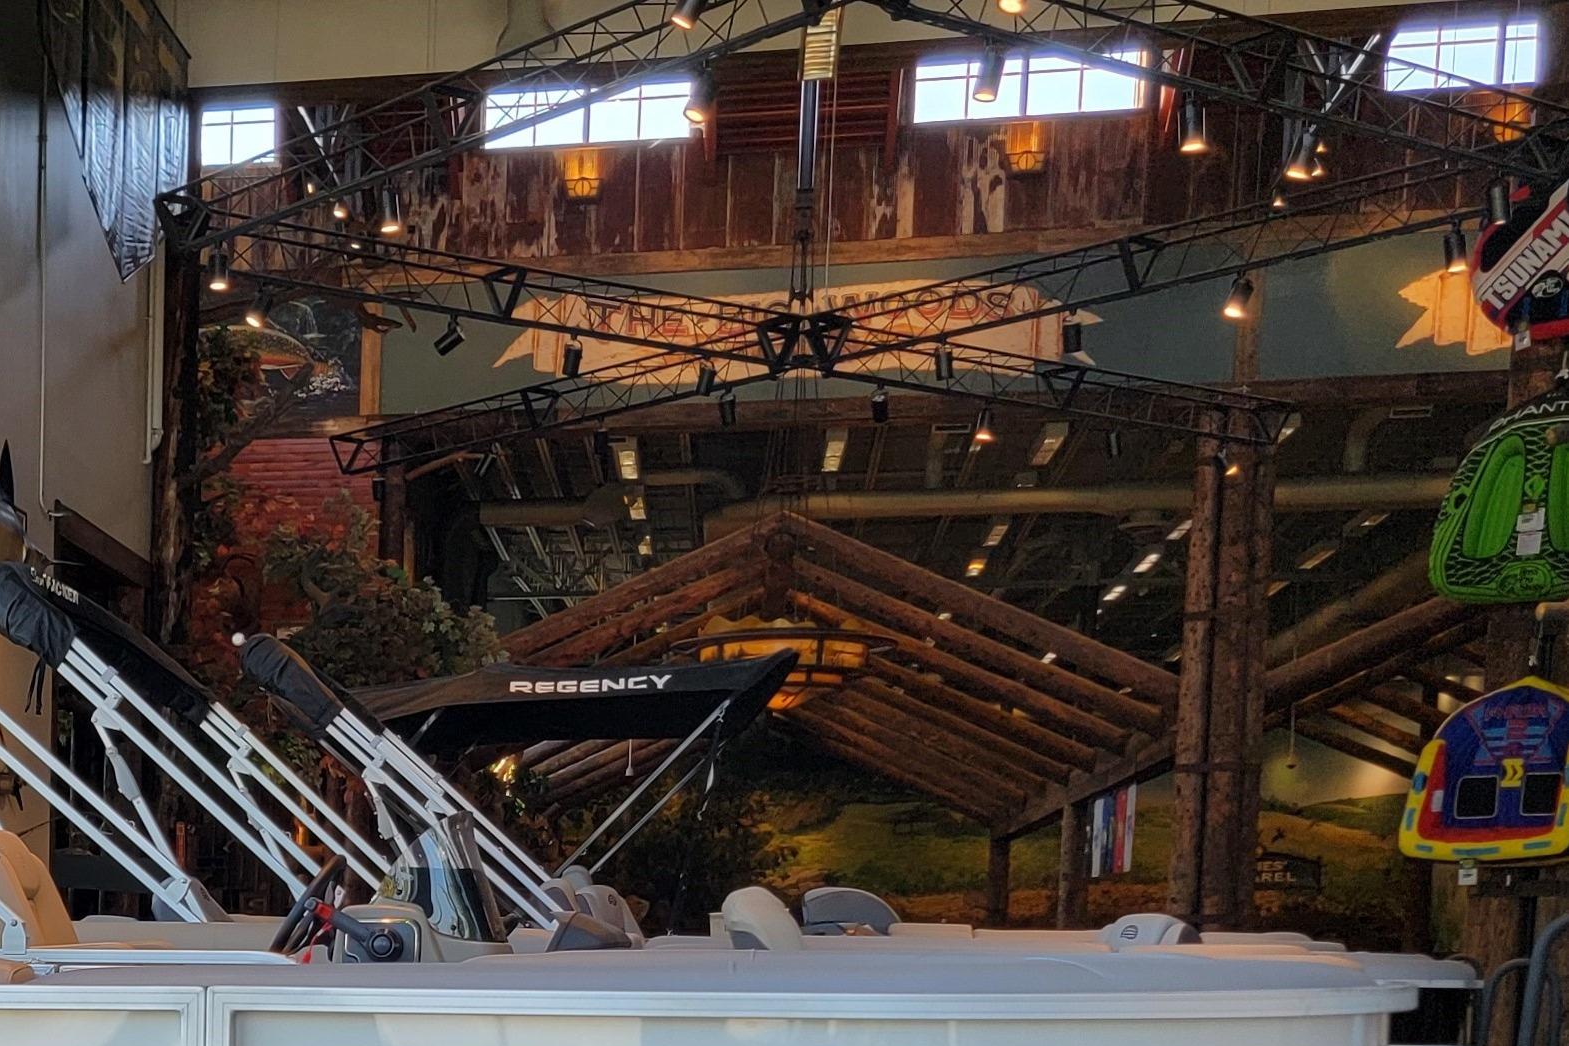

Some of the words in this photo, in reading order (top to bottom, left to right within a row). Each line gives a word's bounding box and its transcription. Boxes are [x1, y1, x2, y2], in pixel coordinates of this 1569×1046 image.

[589, 299, 688, 336] THE
[822, 289, 1016, 325] WOODS
[508, 674, 673, 694] REGENCY
